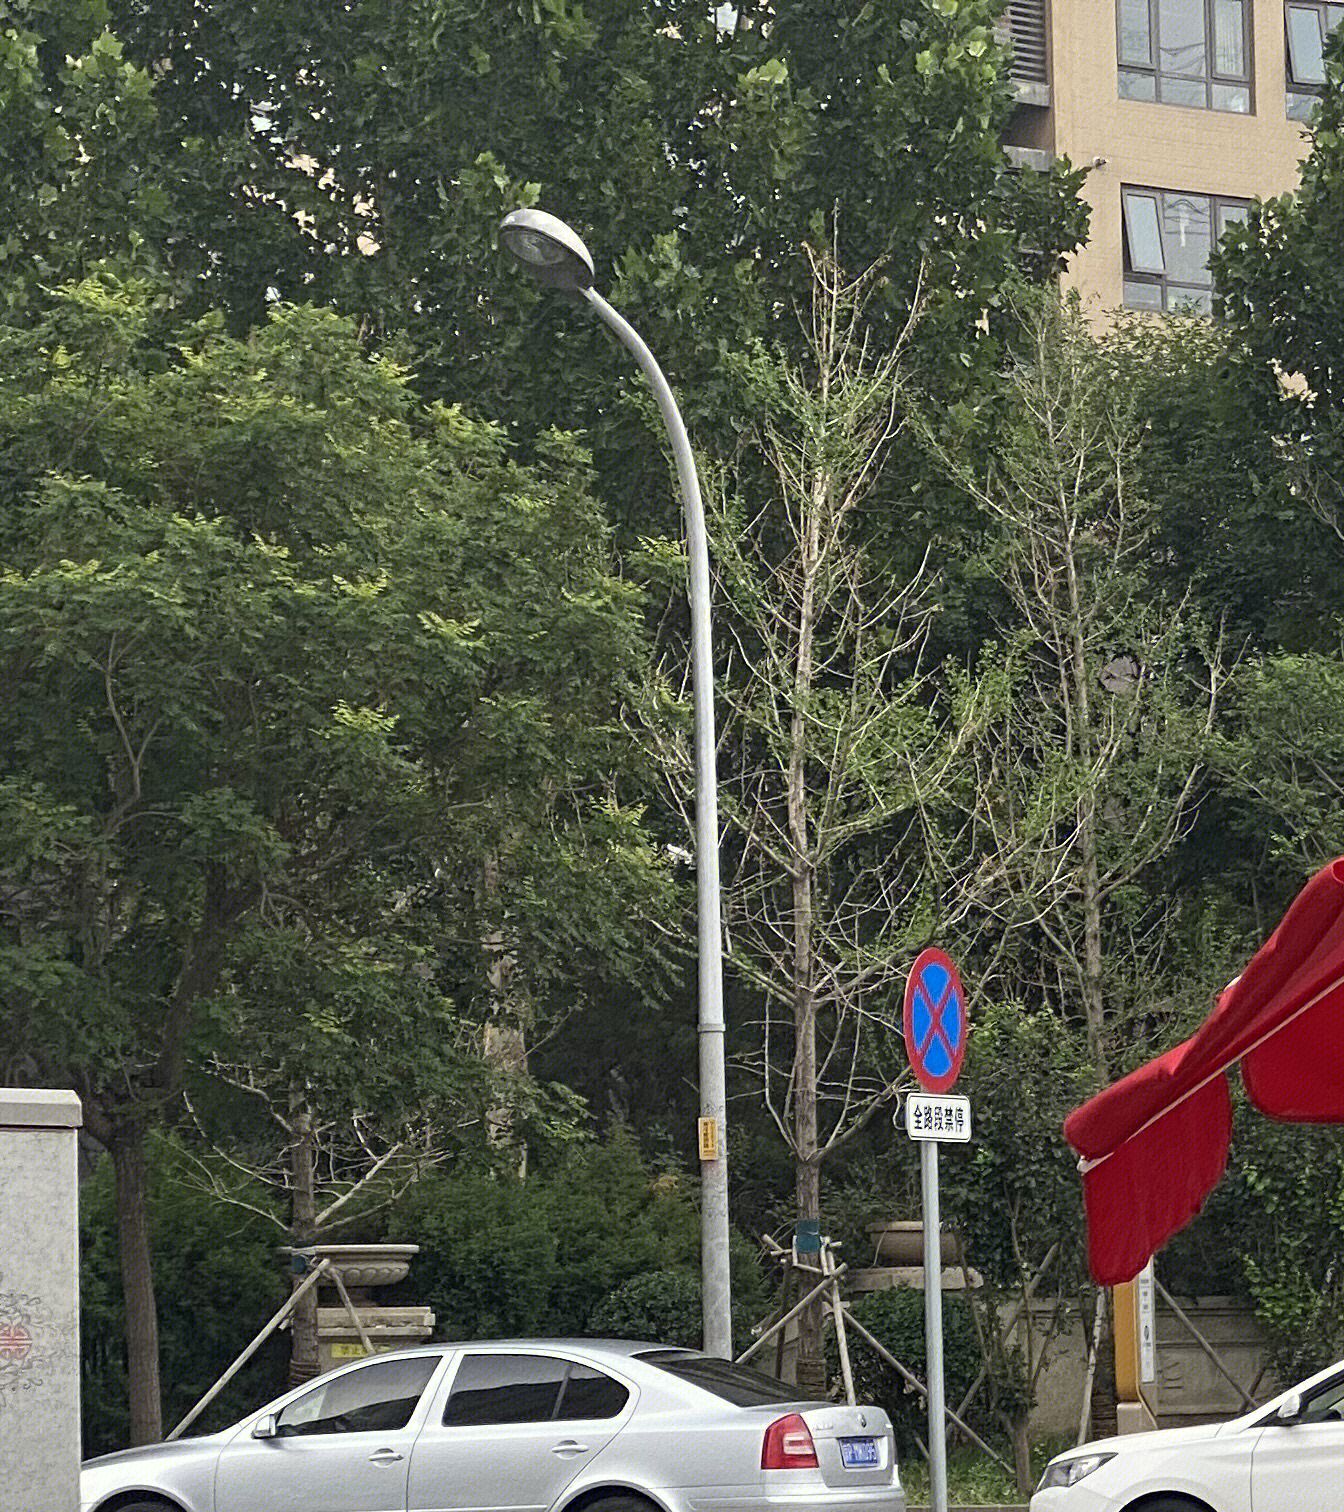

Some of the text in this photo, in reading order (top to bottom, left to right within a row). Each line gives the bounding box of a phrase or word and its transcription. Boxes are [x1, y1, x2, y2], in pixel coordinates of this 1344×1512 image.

[914, 1104, 964, 1132] 全路段禁停
